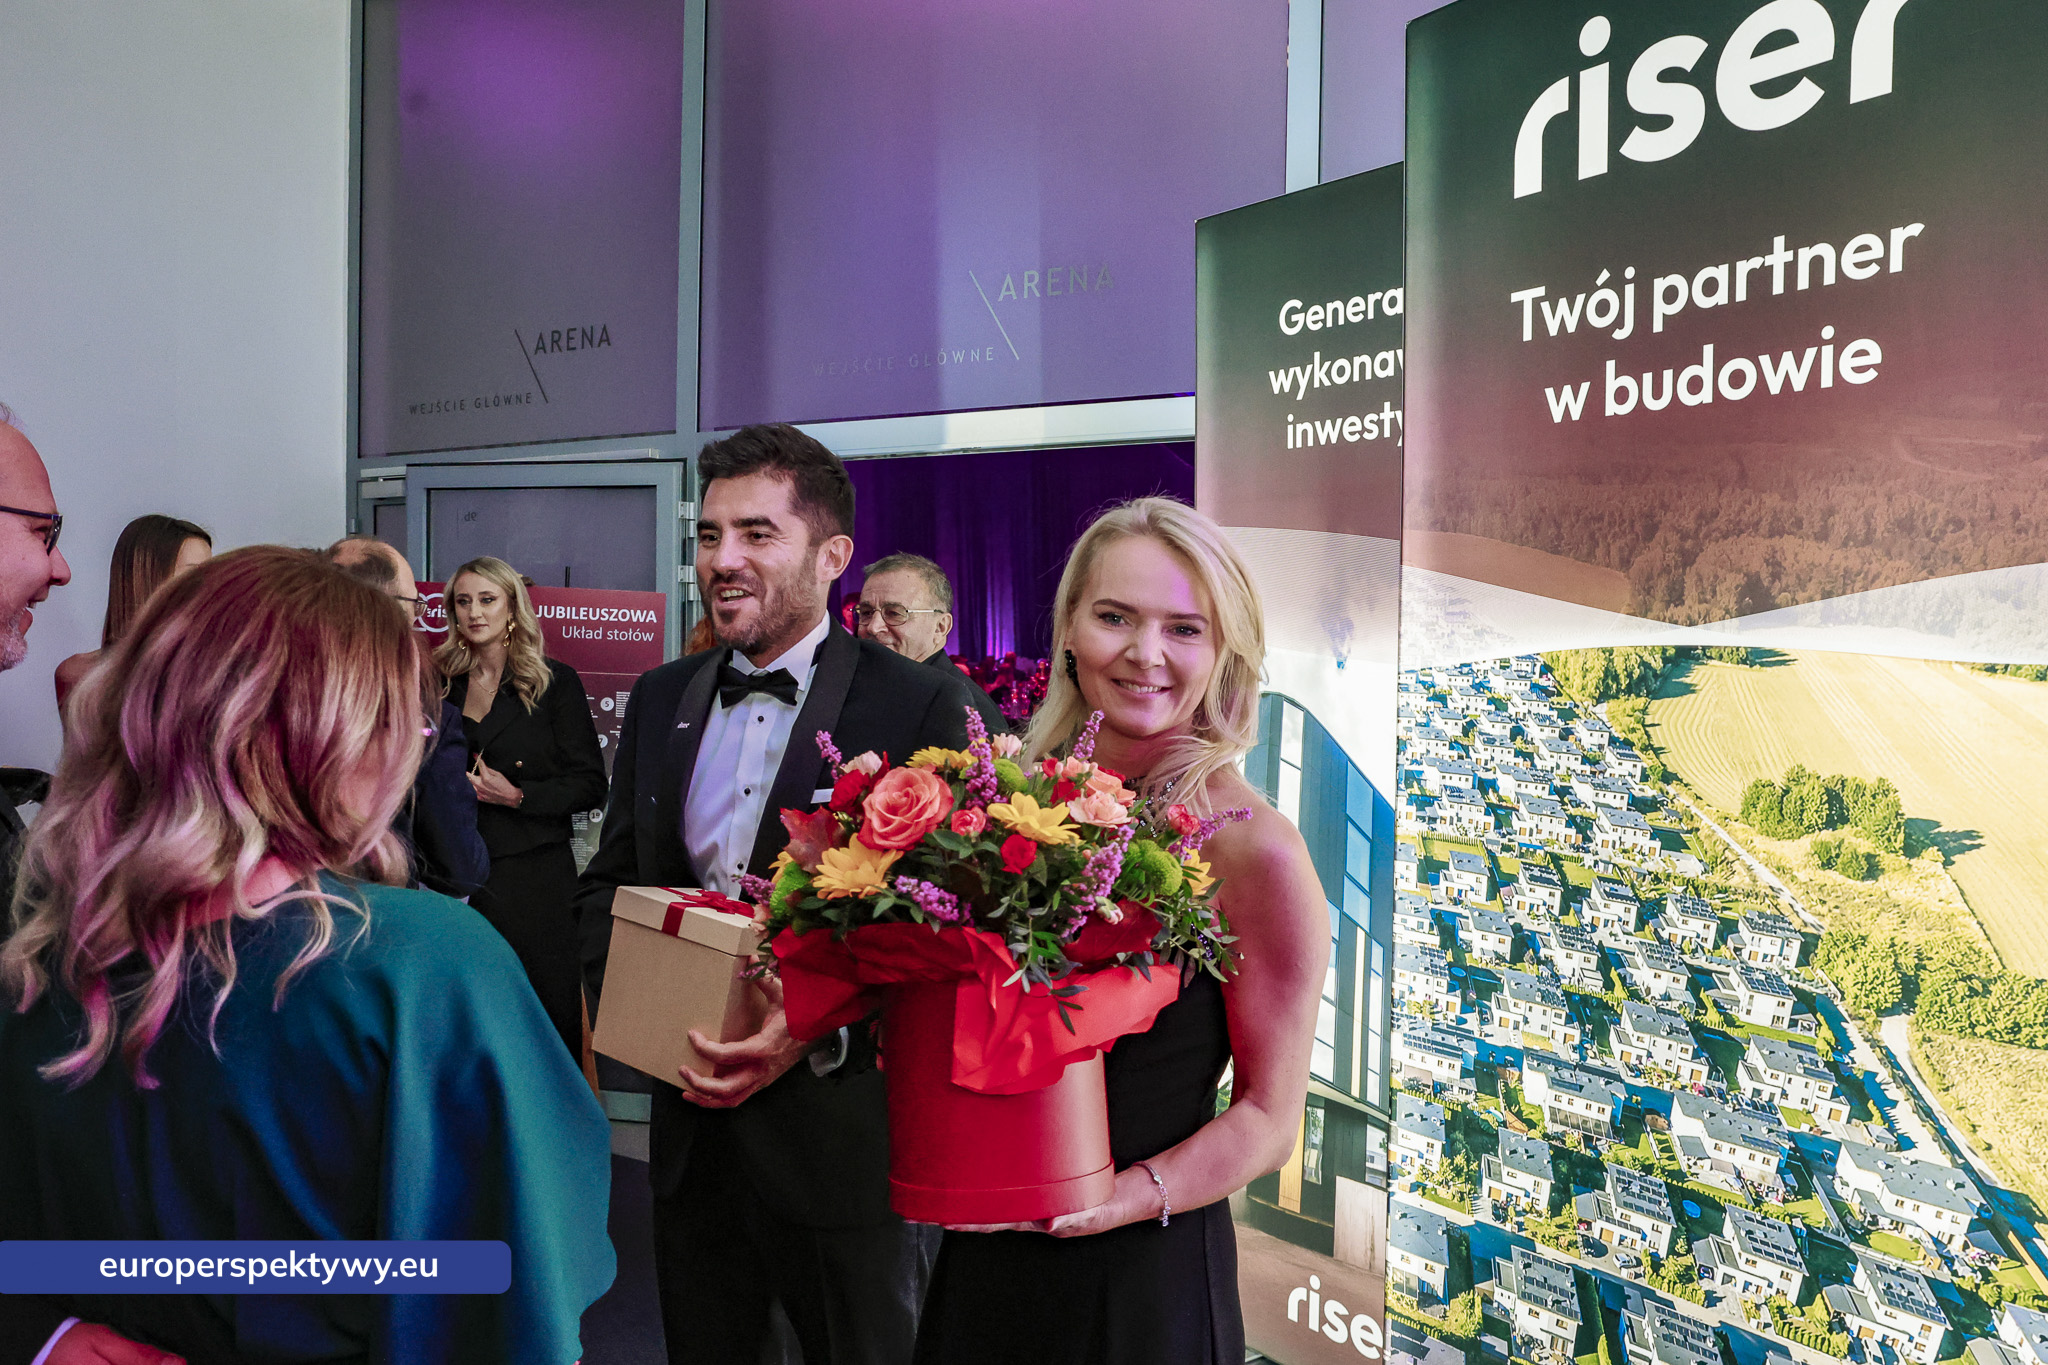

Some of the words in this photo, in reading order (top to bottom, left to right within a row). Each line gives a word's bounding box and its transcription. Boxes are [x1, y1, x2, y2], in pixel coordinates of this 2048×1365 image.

[1513, 0, 1908, 200] riser
[998, 263, 1116, 303] ARENA
[1510, 267, 1636, 342] Twój
[1652, 222, 1925, 333] partner
[534, 323, 612, 356] ARENA
[1544, 381, 1591, 424] w
[1605, 325, 1882, 417] budowie
[536, 604, 657, 623] JUBILEUSZOWA
[562, 625, 603, 640] Układ
[606, 627, 655, 642] stołów
